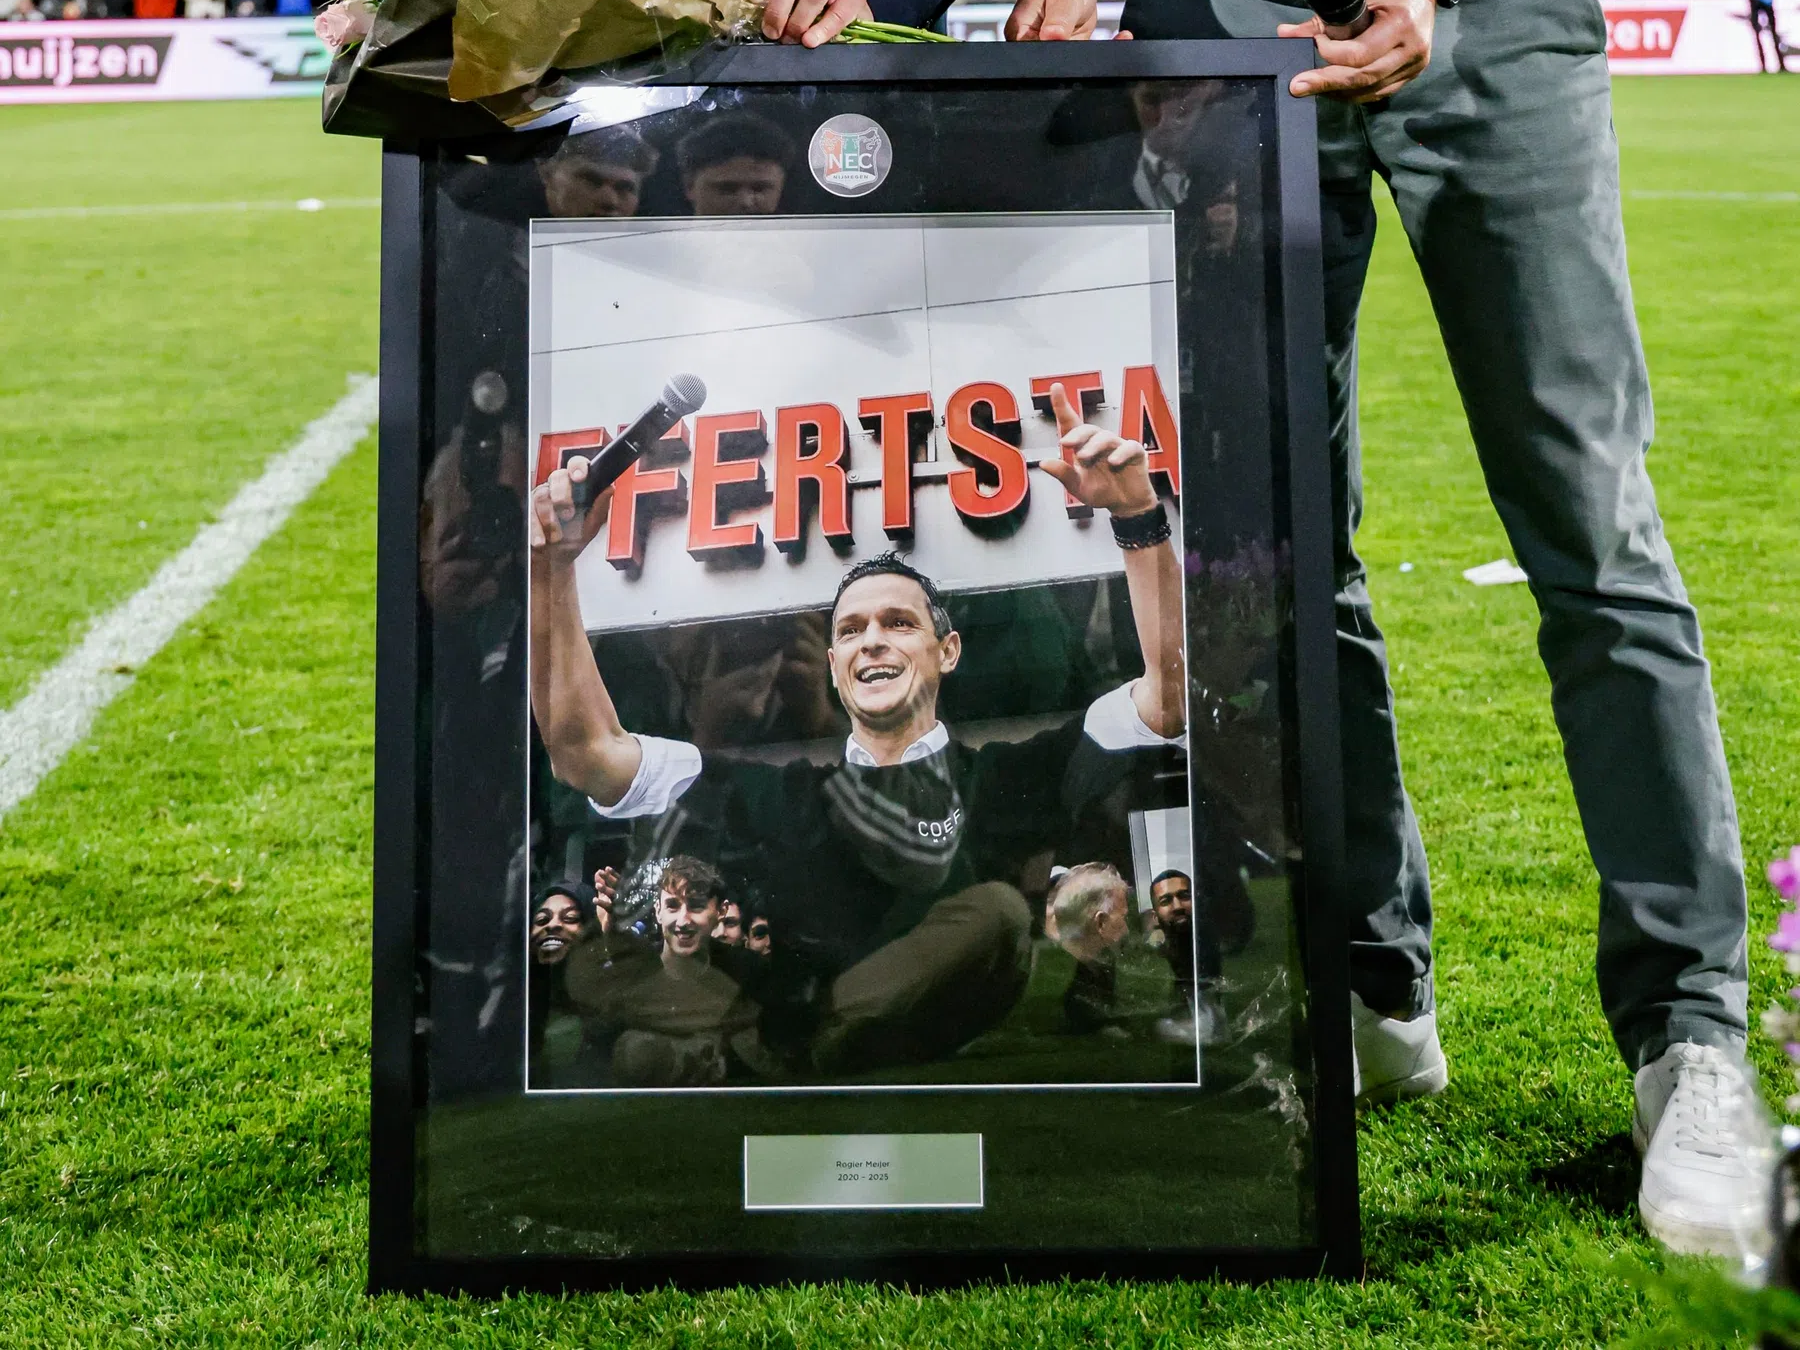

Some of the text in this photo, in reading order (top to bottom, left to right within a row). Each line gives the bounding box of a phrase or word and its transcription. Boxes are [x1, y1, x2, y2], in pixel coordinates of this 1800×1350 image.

[828, 153, 873, 169] NEC
[836, 1160, 890, 1169] Rogier Meijer
[837, 1173, 859, 1181] 2020
[868, 1173, 889, 1181] 2025
